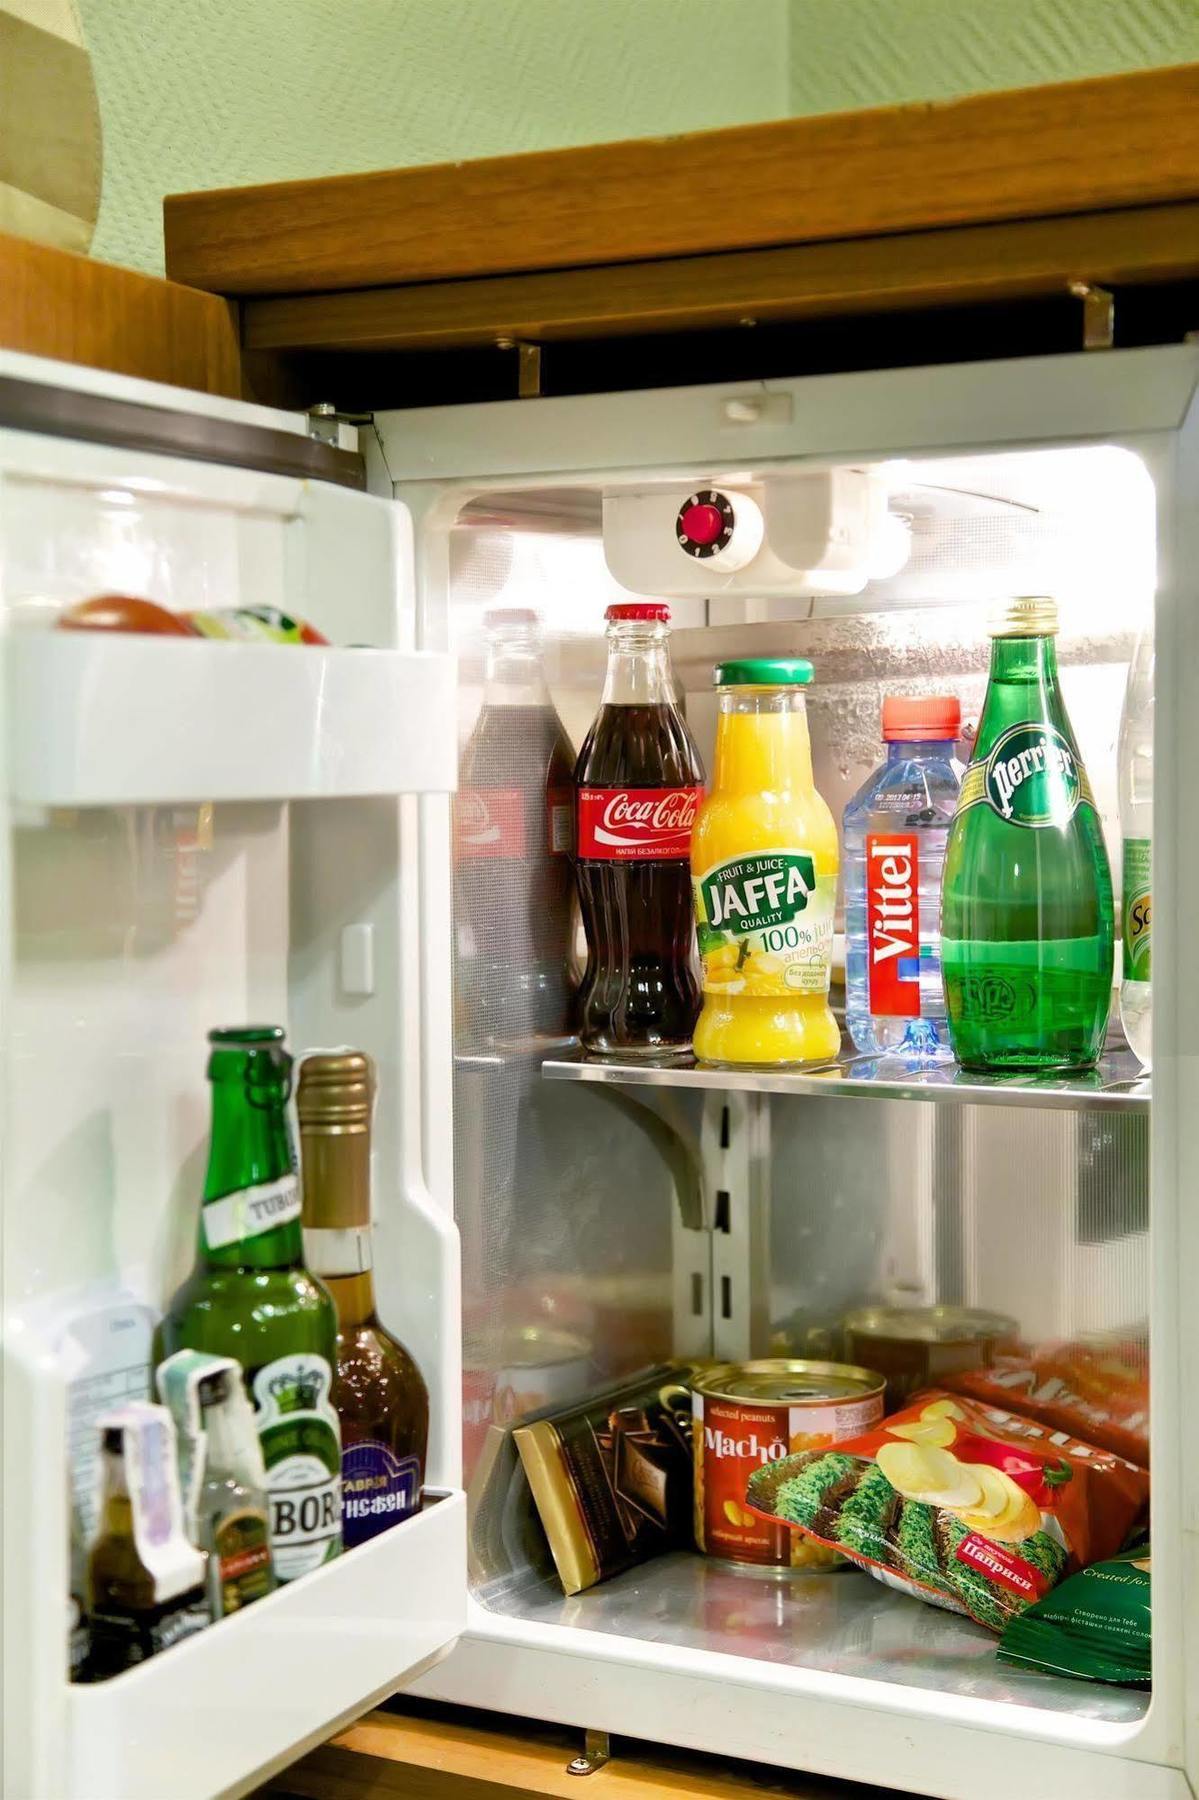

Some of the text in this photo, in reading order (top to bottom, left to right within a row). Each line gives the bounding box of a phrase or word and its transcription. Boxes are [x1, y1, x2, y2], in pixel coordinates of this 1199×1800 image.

[604, 792, 697, 829] Coca-Cola
[718, 858, 784, 882] FRUIT & JUICE
[709, 866, 808, 926] JAFFA
[872, 843, 913, 964] Vittel
[740, 912, 783, 930] QUALITY
[760, 926, 812, 952] 100%
[740, 1412, 776, 1423] peanuts
[704, 1426, 788, 1464] Macho
[962, 1541, 1032, 1590] Паприки
[1083, 1568, 1150, 1586] Created for
[1074, 1608, 1108, 1622] Створено
[1122, 1617, 1138, 1627] Тебе
